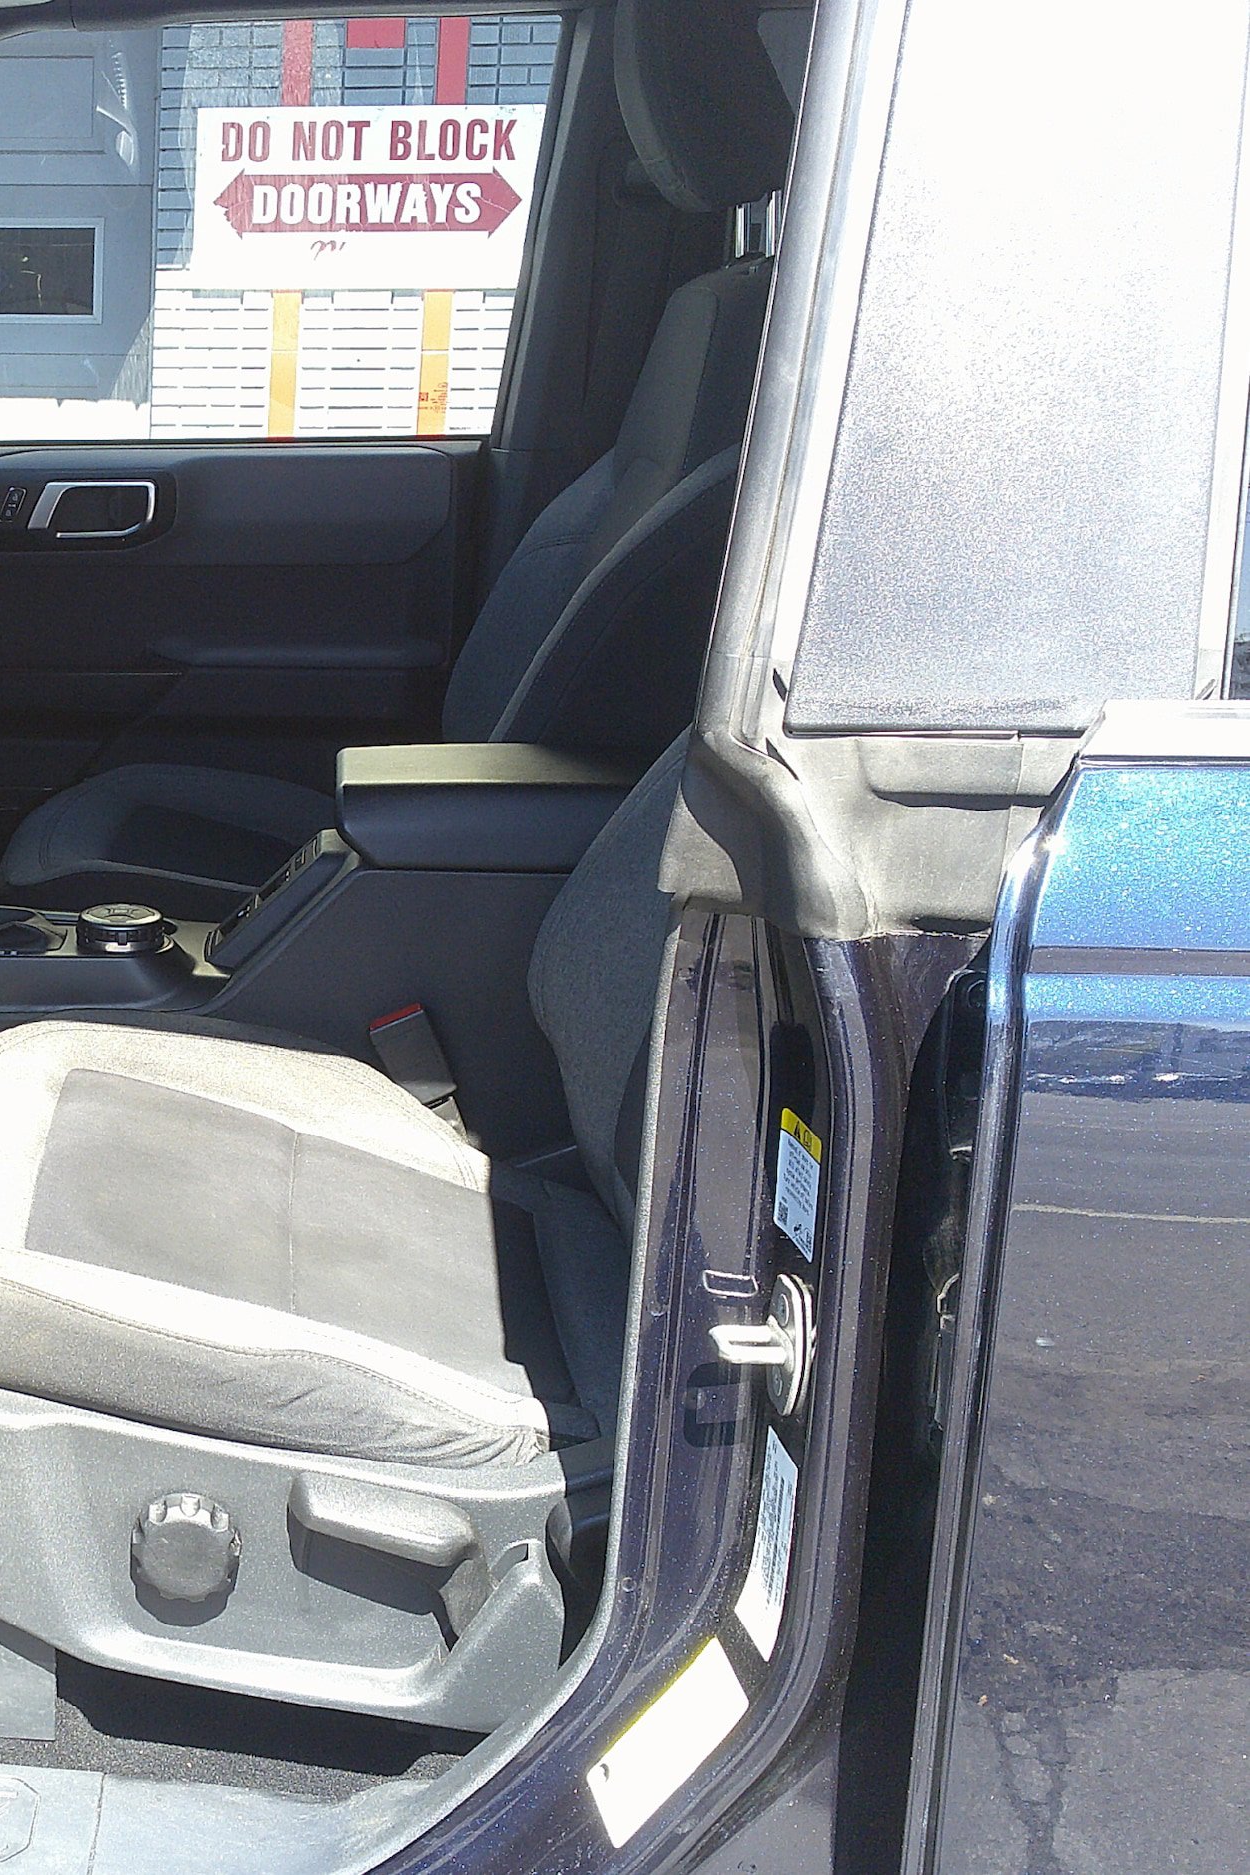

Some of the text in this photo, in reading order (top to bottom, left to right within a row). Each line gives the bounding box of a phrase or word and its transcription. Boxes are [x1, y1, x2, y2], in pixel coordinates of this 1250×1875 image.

[221, 119, 517, 162] DO NOT BLOCK
[251, 182, 482, 225] DOORWAYS
